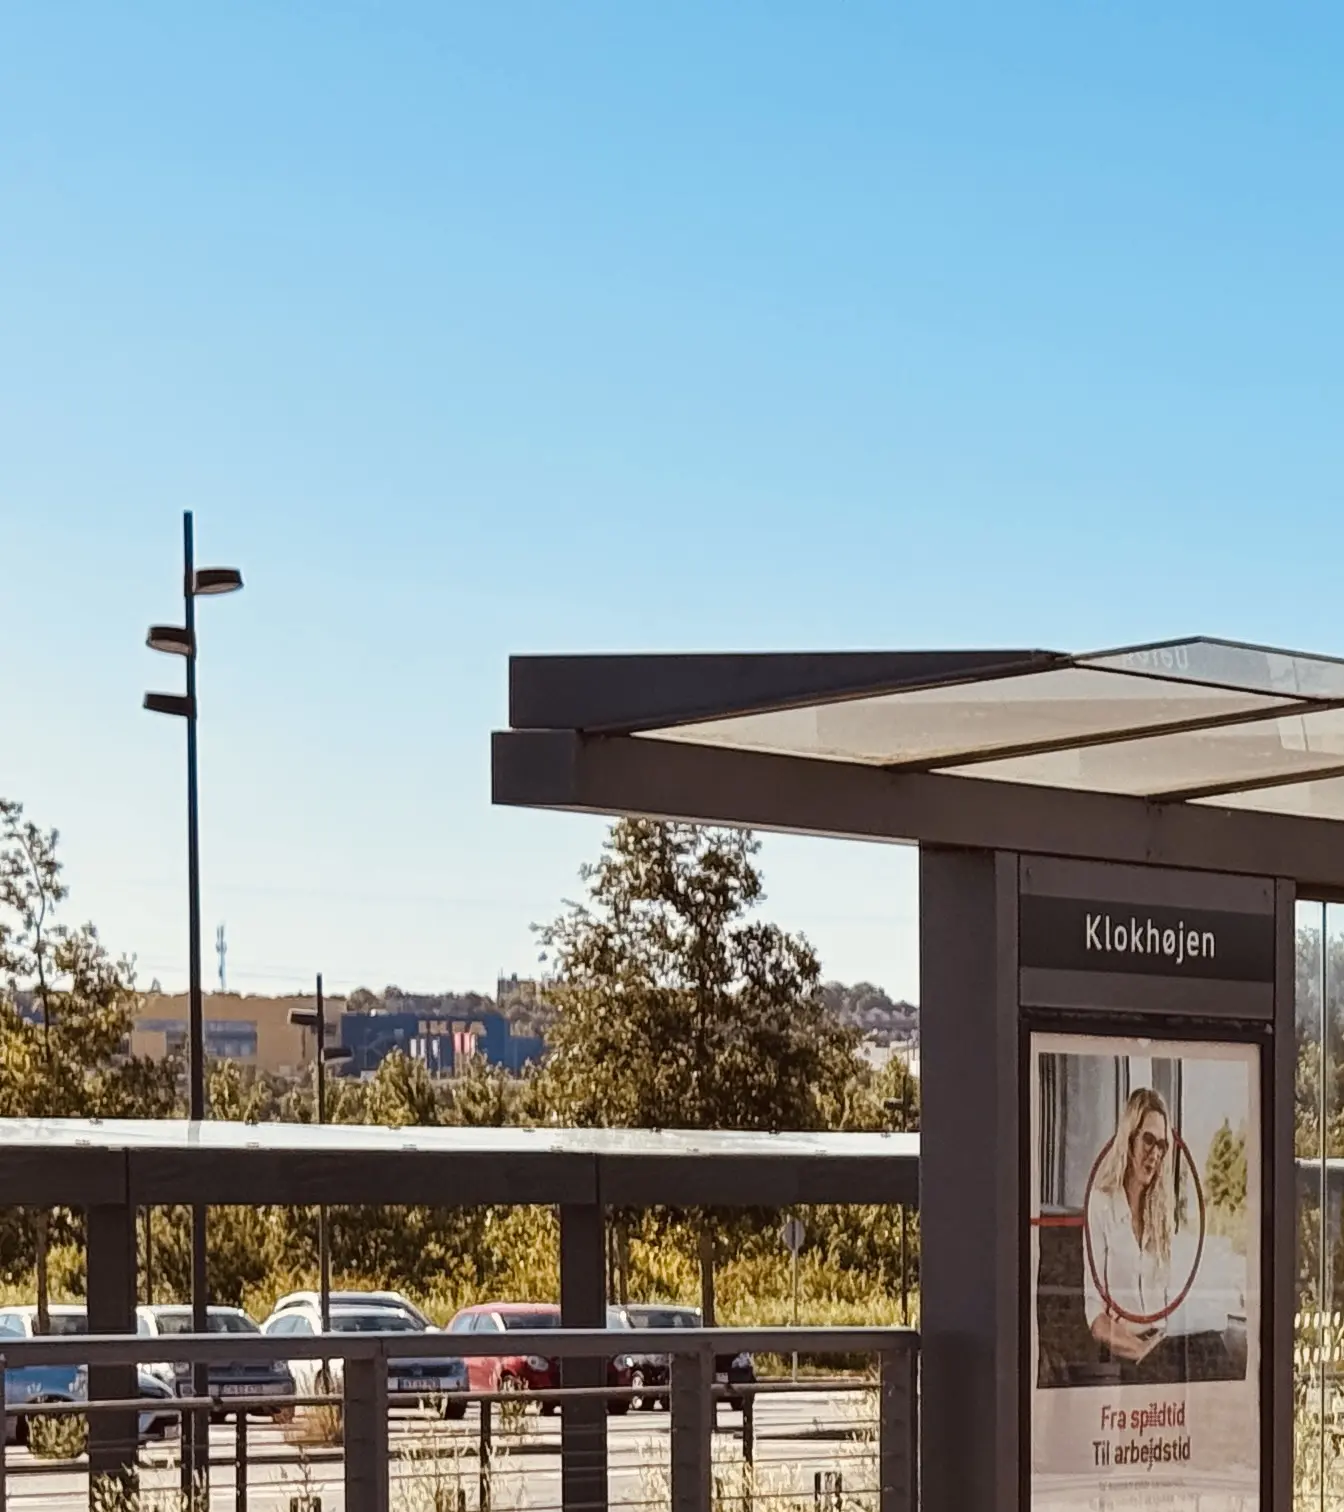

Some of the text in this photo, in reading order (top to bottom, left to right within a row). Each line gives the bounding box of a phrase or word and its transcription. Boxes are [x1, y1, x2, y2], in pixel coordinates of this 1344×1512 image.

[1086, 913, 1215, 964] Klokhøjen
[1101, 1400, 1185, 1436] Fra spildtid
[1093, 1435, 1191, 1472] Til arbejdstid
